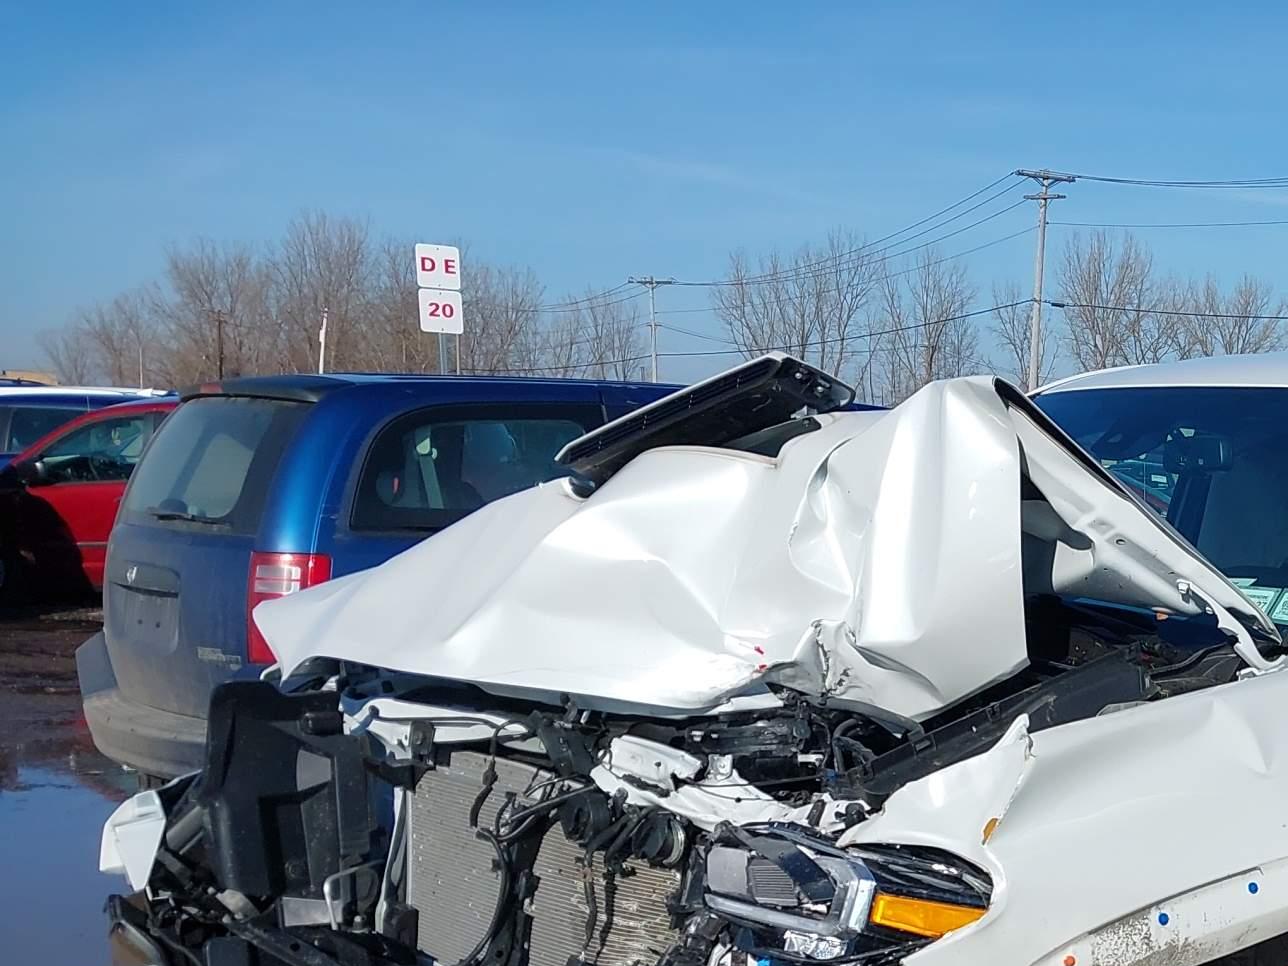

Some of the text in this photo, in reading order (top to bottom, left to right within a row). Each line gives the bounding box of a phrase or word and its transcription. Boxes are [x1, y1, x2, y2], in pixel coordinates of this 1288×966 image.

[420, 256, 457, 275] D E
[428, 302, 454, 318] 20
